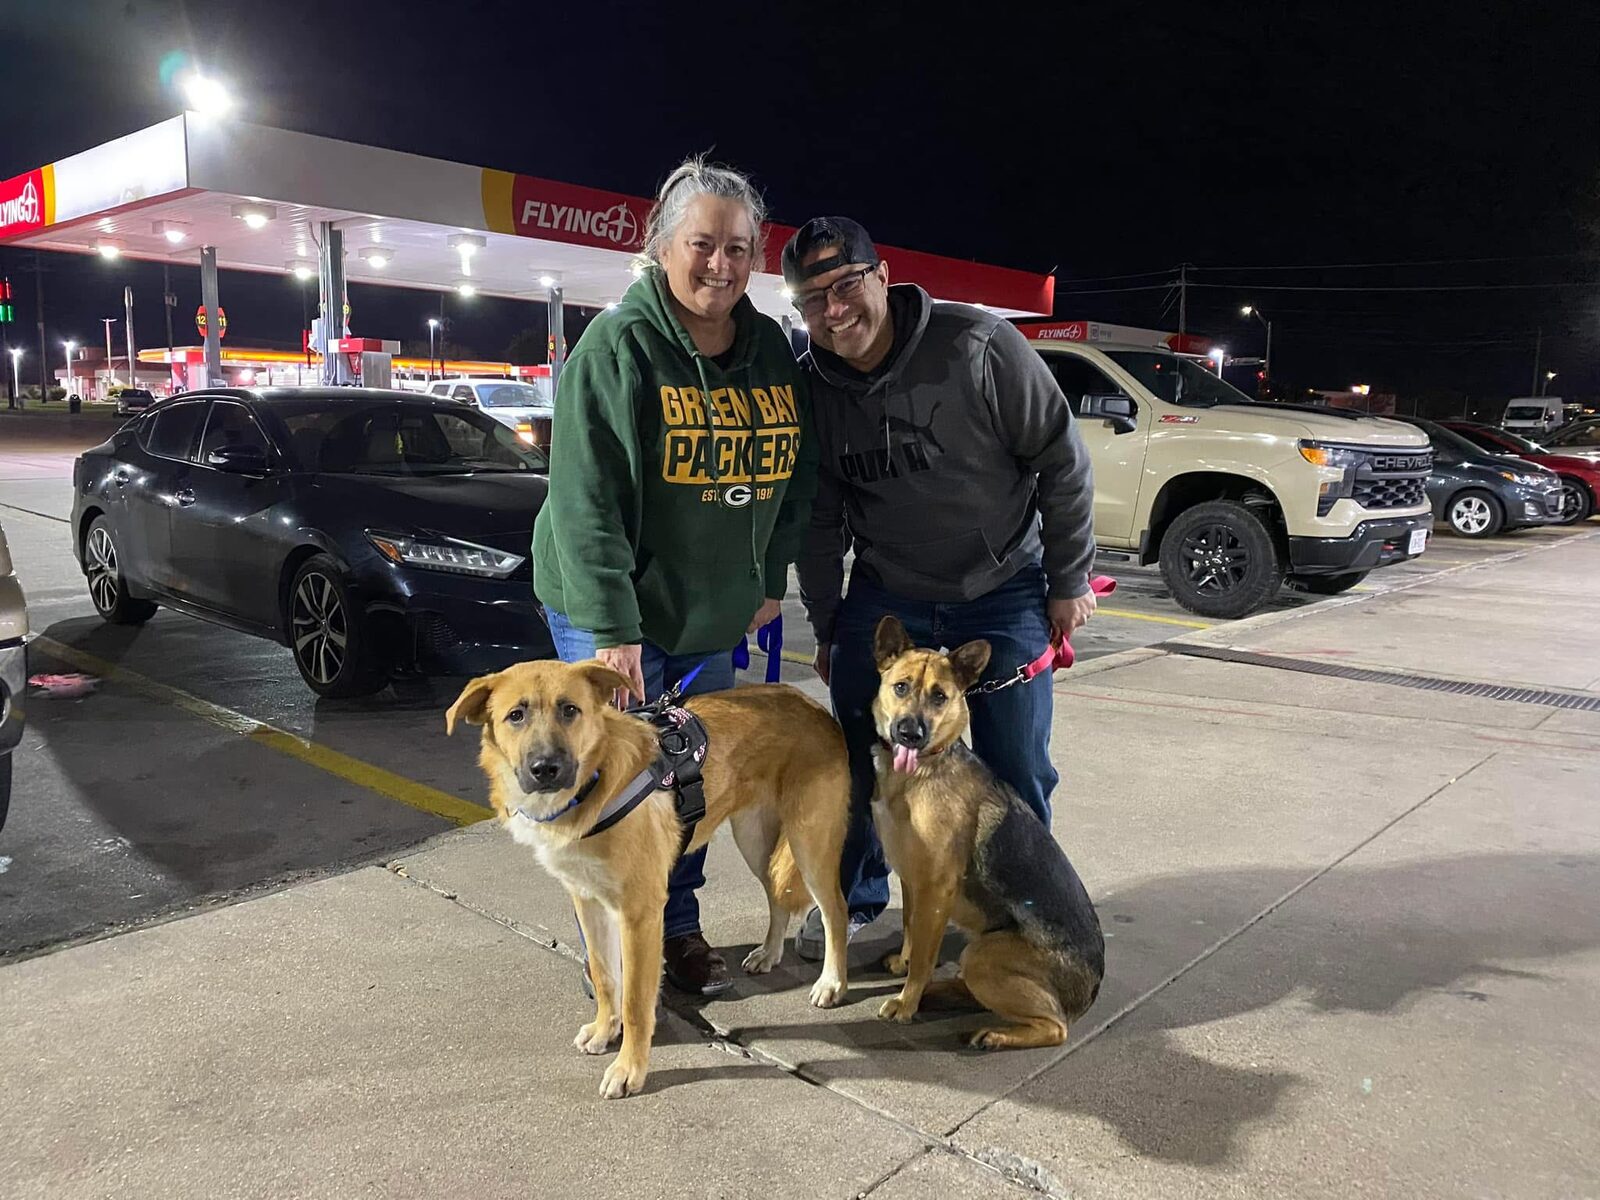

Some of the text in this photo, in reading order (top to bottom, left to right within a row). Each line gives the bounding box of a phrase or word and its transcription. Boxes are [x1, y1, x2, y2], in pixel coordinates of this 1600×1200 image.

[0, 193, 25, 228] LYING
[196, 315, 207, 325] 12
[218, 316, 227, 327] 11
[660, 385, 798, 427] GREEN BAY
[667, 432, 801, 478] PACKERS
